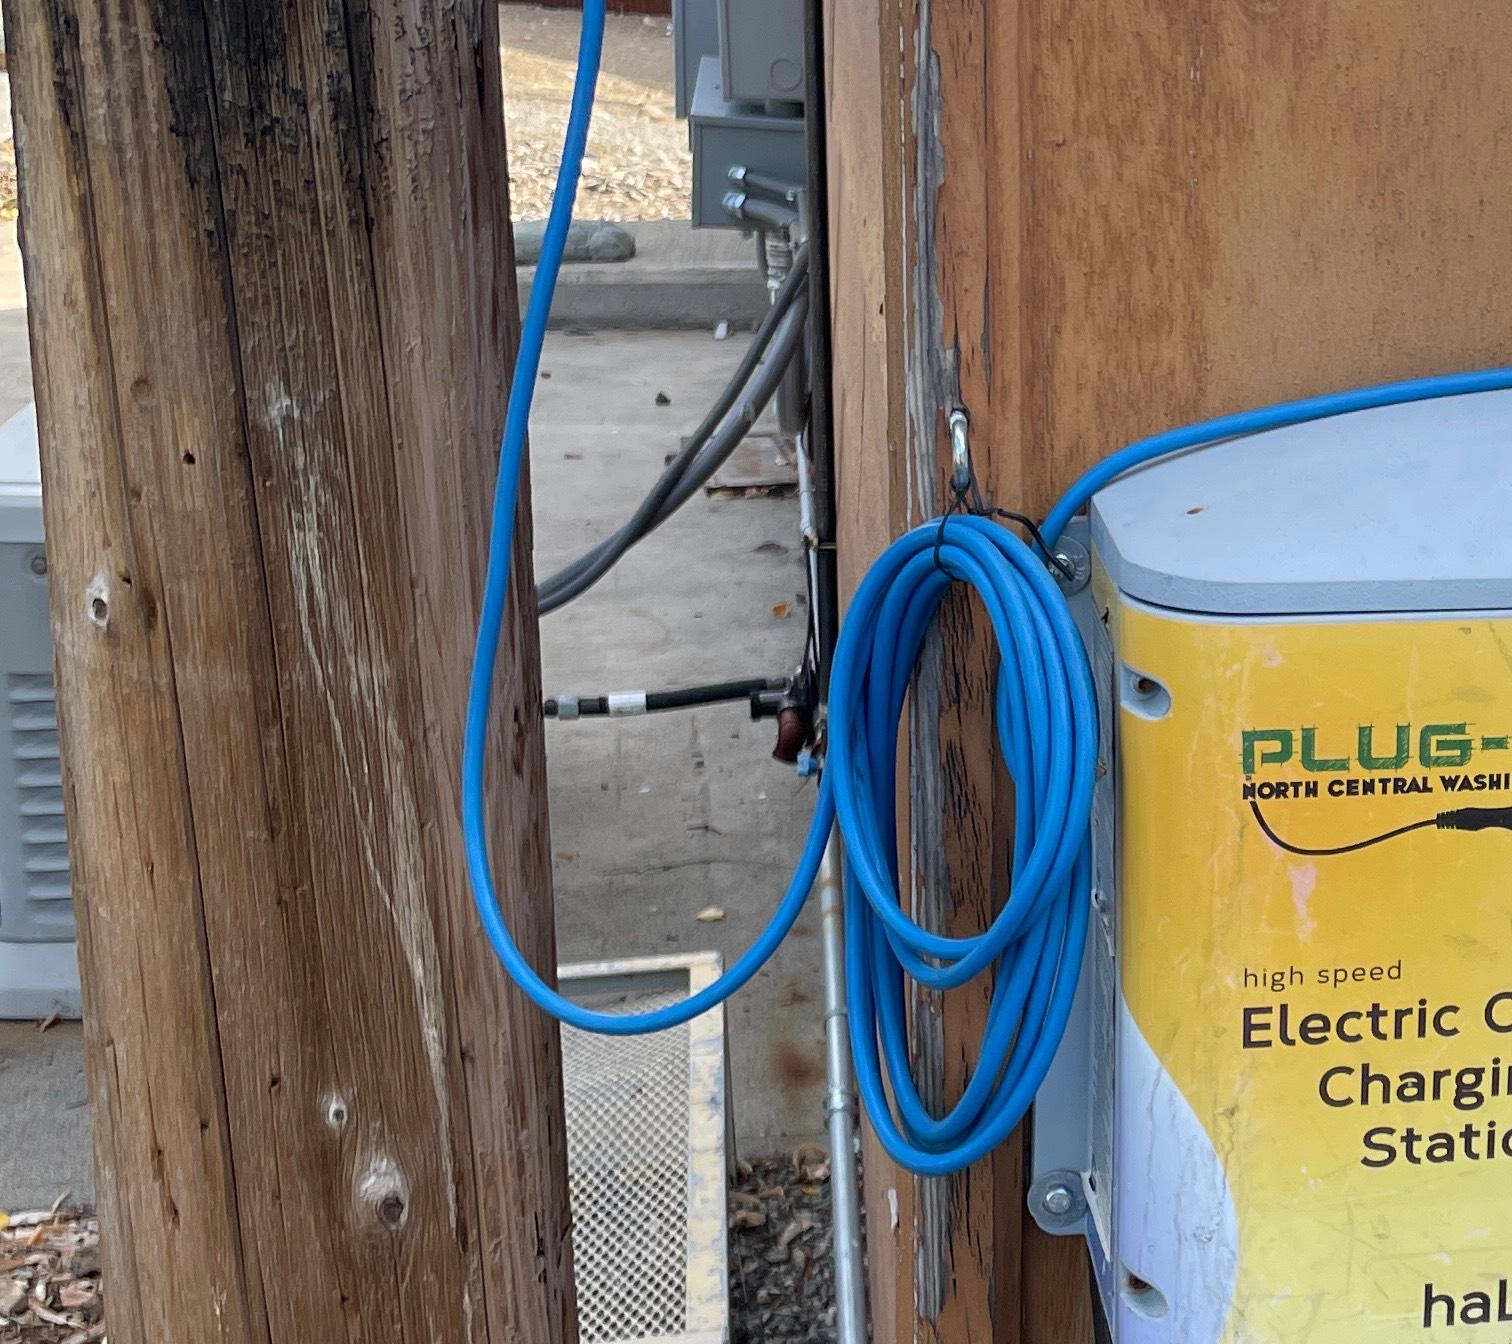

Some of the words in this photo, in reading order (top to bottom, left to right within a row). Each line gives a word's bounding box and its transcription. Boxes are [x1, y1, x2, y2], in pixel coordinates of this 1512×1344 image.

[1242, 780, 1319, 801] NORTH
[1327, 775, 1433, 797] CENTRAL
[1243, 966, 1305, 992] high
[1317, 959, 1402, 988] speed
[1242, 998, 1461, 1049] Electric
